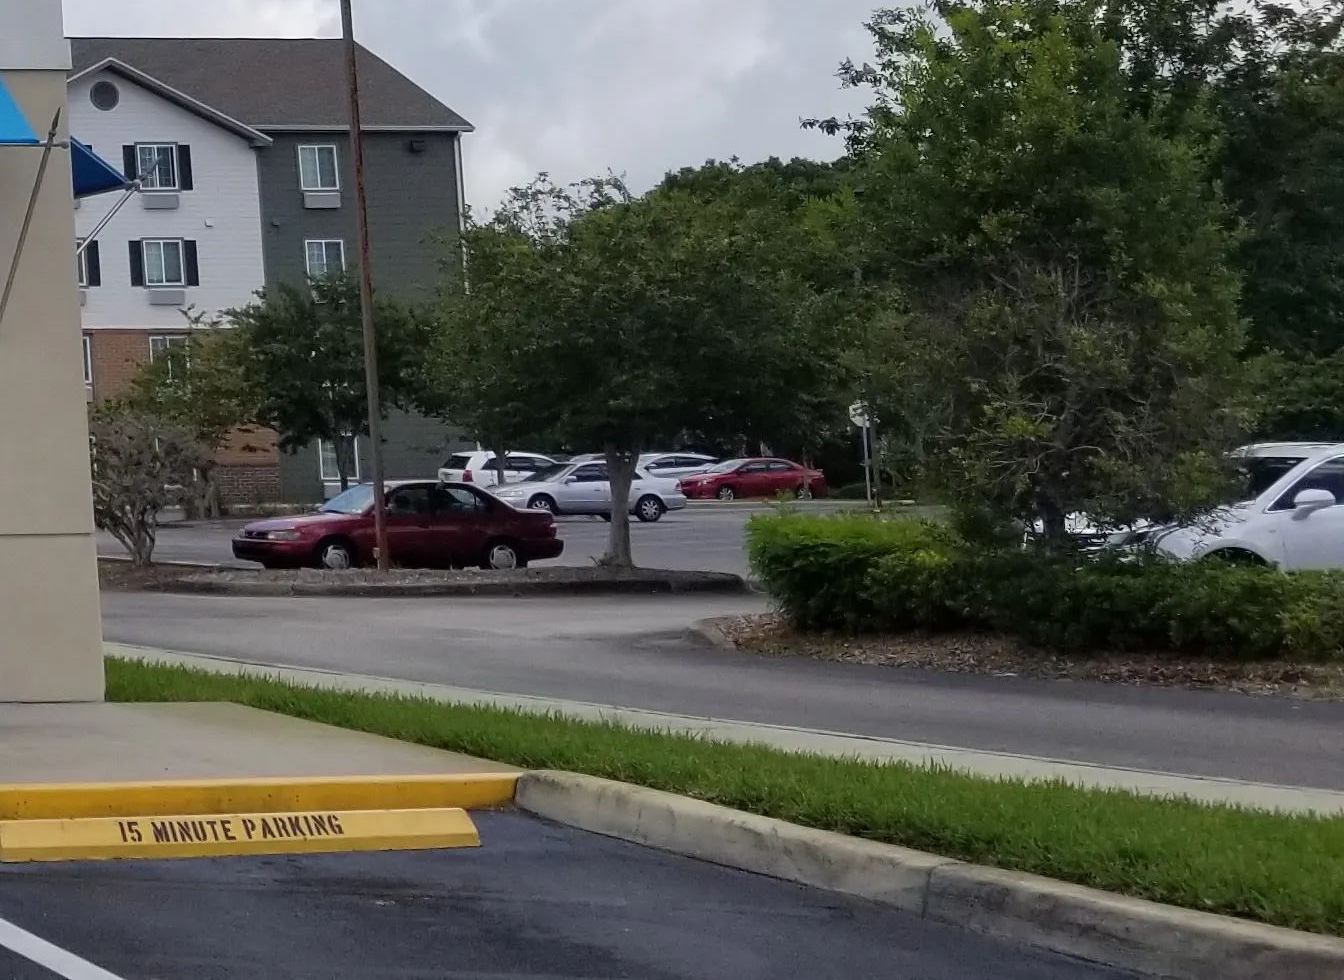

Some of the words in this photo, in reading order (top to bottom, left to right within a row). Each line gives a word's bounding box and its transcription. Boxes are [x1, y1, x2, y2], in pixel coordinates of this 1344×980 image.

[118, 820, 143, 842] 15
[151, 819, 237, 843] MINUTE
[242, 814, 345, 840] PARKING
